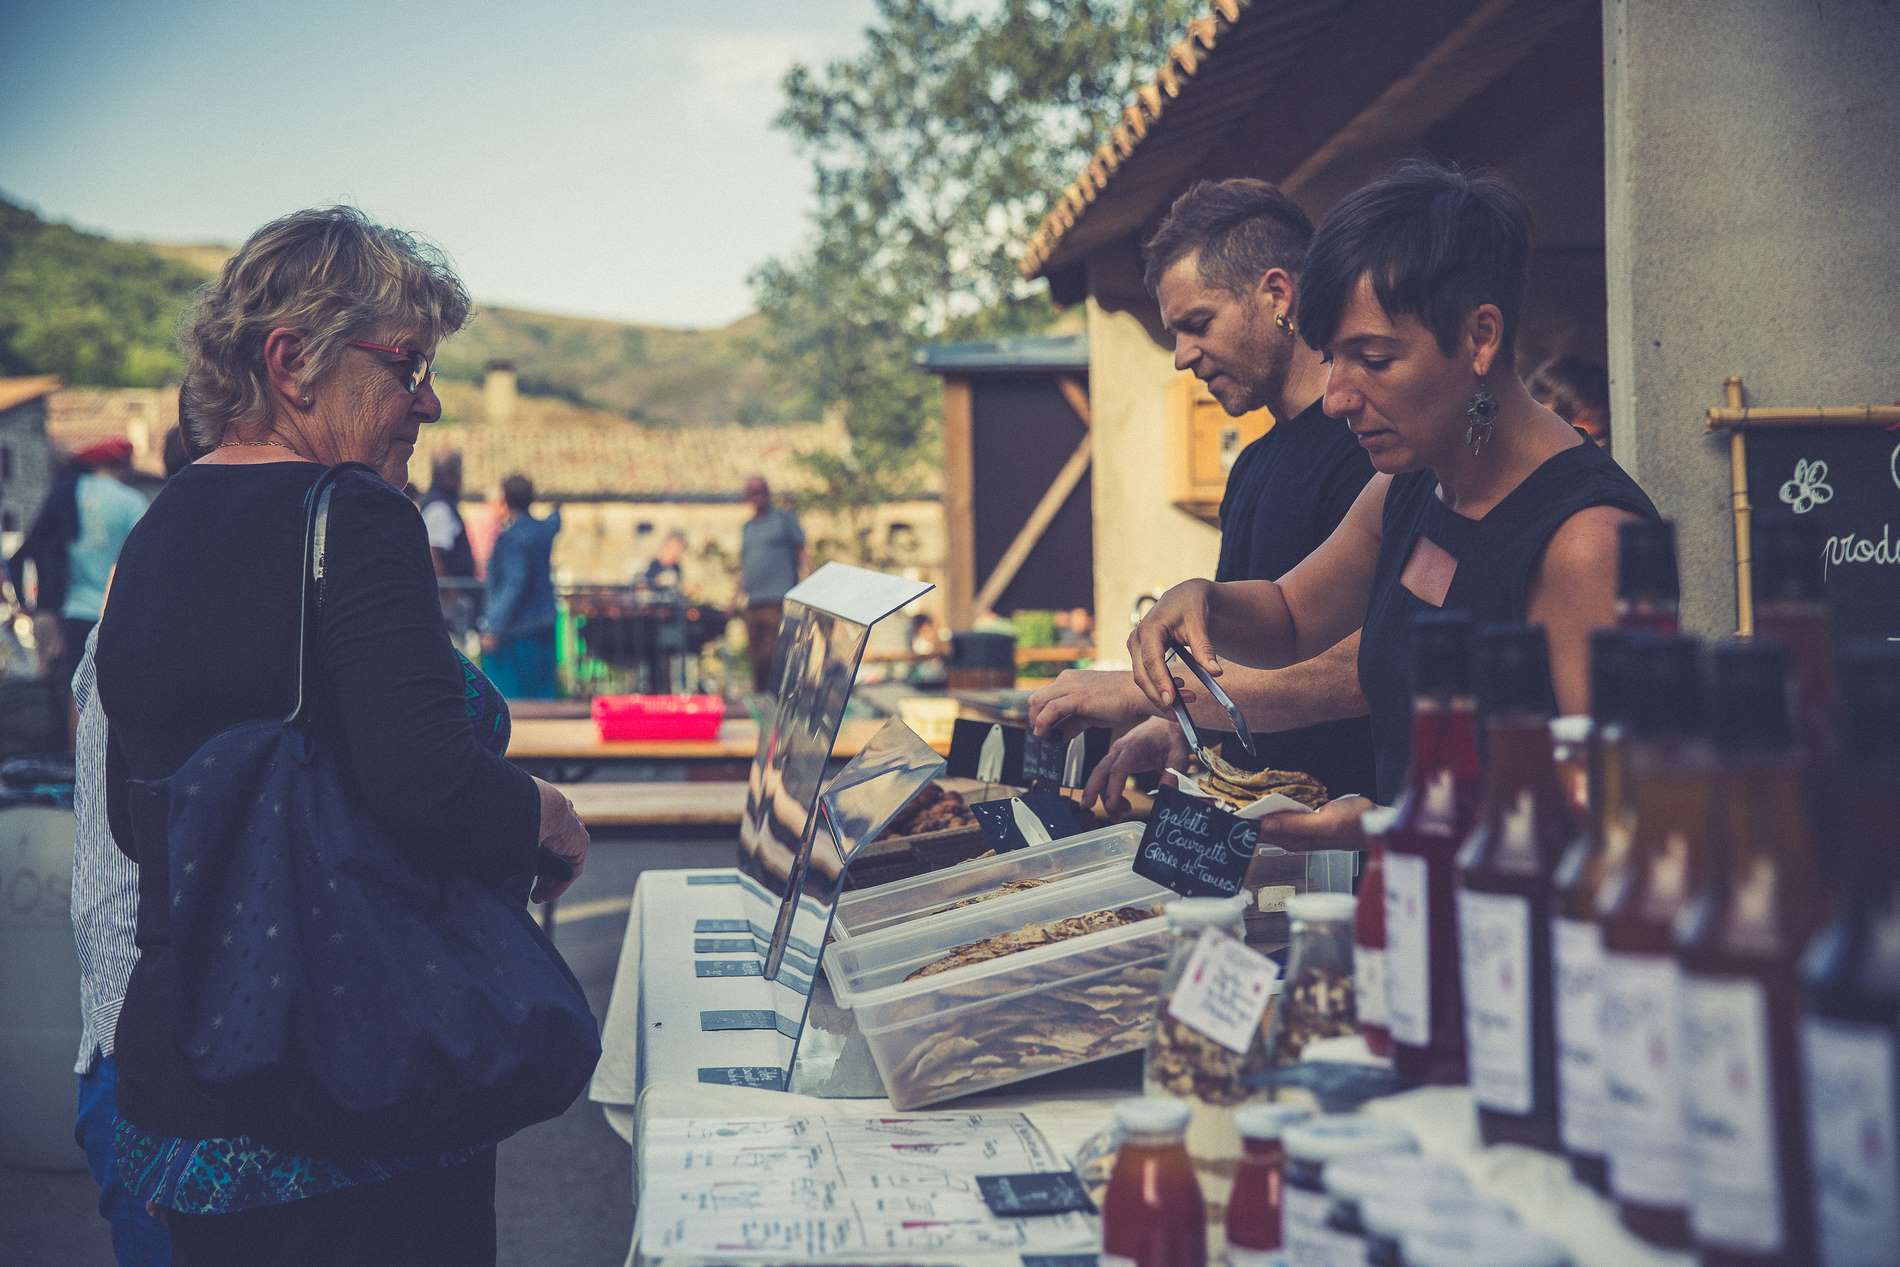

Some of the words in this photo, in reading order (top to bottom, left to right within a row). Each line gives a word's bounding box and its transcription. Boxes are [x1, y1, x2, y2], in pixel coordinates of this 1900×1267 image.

[1820, 523, 1900, 584] prod
[1155, 806, 1209, 838] galette
[1166, 829, 1229, 868] Courgette
[1181, 860, 1195, 875] de
